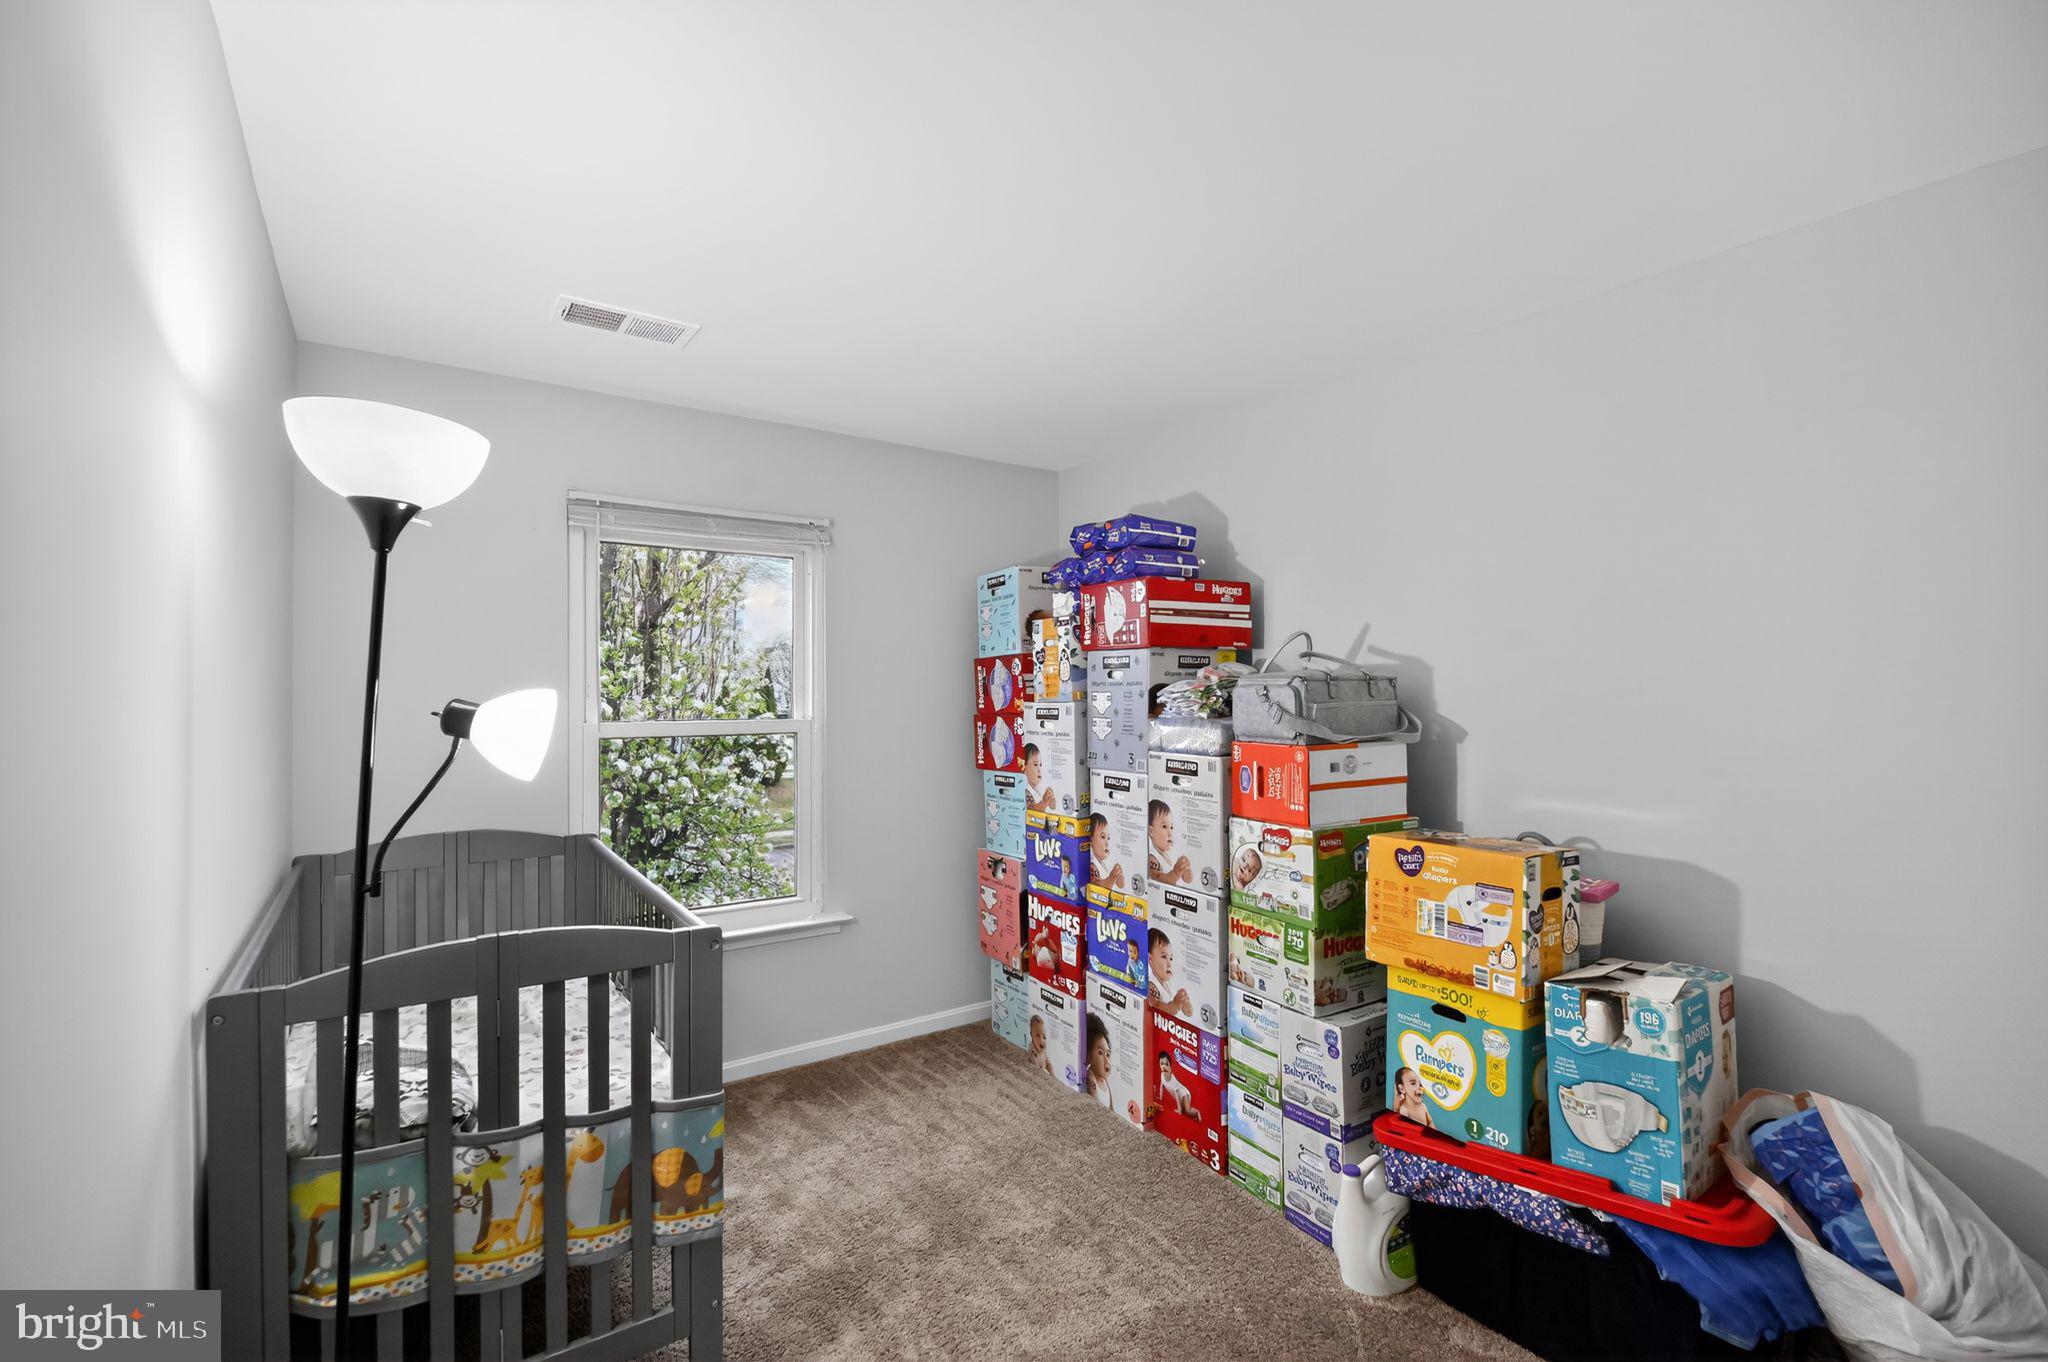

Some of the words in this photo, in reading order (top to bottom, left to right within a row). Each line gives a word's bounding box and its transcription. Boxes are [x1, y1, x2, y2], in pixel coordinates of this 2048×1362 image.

[1201, 871, 1210, 886] 3
[1323, 935, 1364, 959] HUGG
[1201, 1008, 1209, 1023] 3
[1153, 1012, 1198, 1047] HUGGIES
[1576, 1030, 1584, 1043] 2
[1415, 1044, 1464, 1078] Pampers
[1471, 1120, 1477, 1132] 1
[1485, 1126, 1508, 1146] 210
[1210, 1149, 1221, 1171] 3
